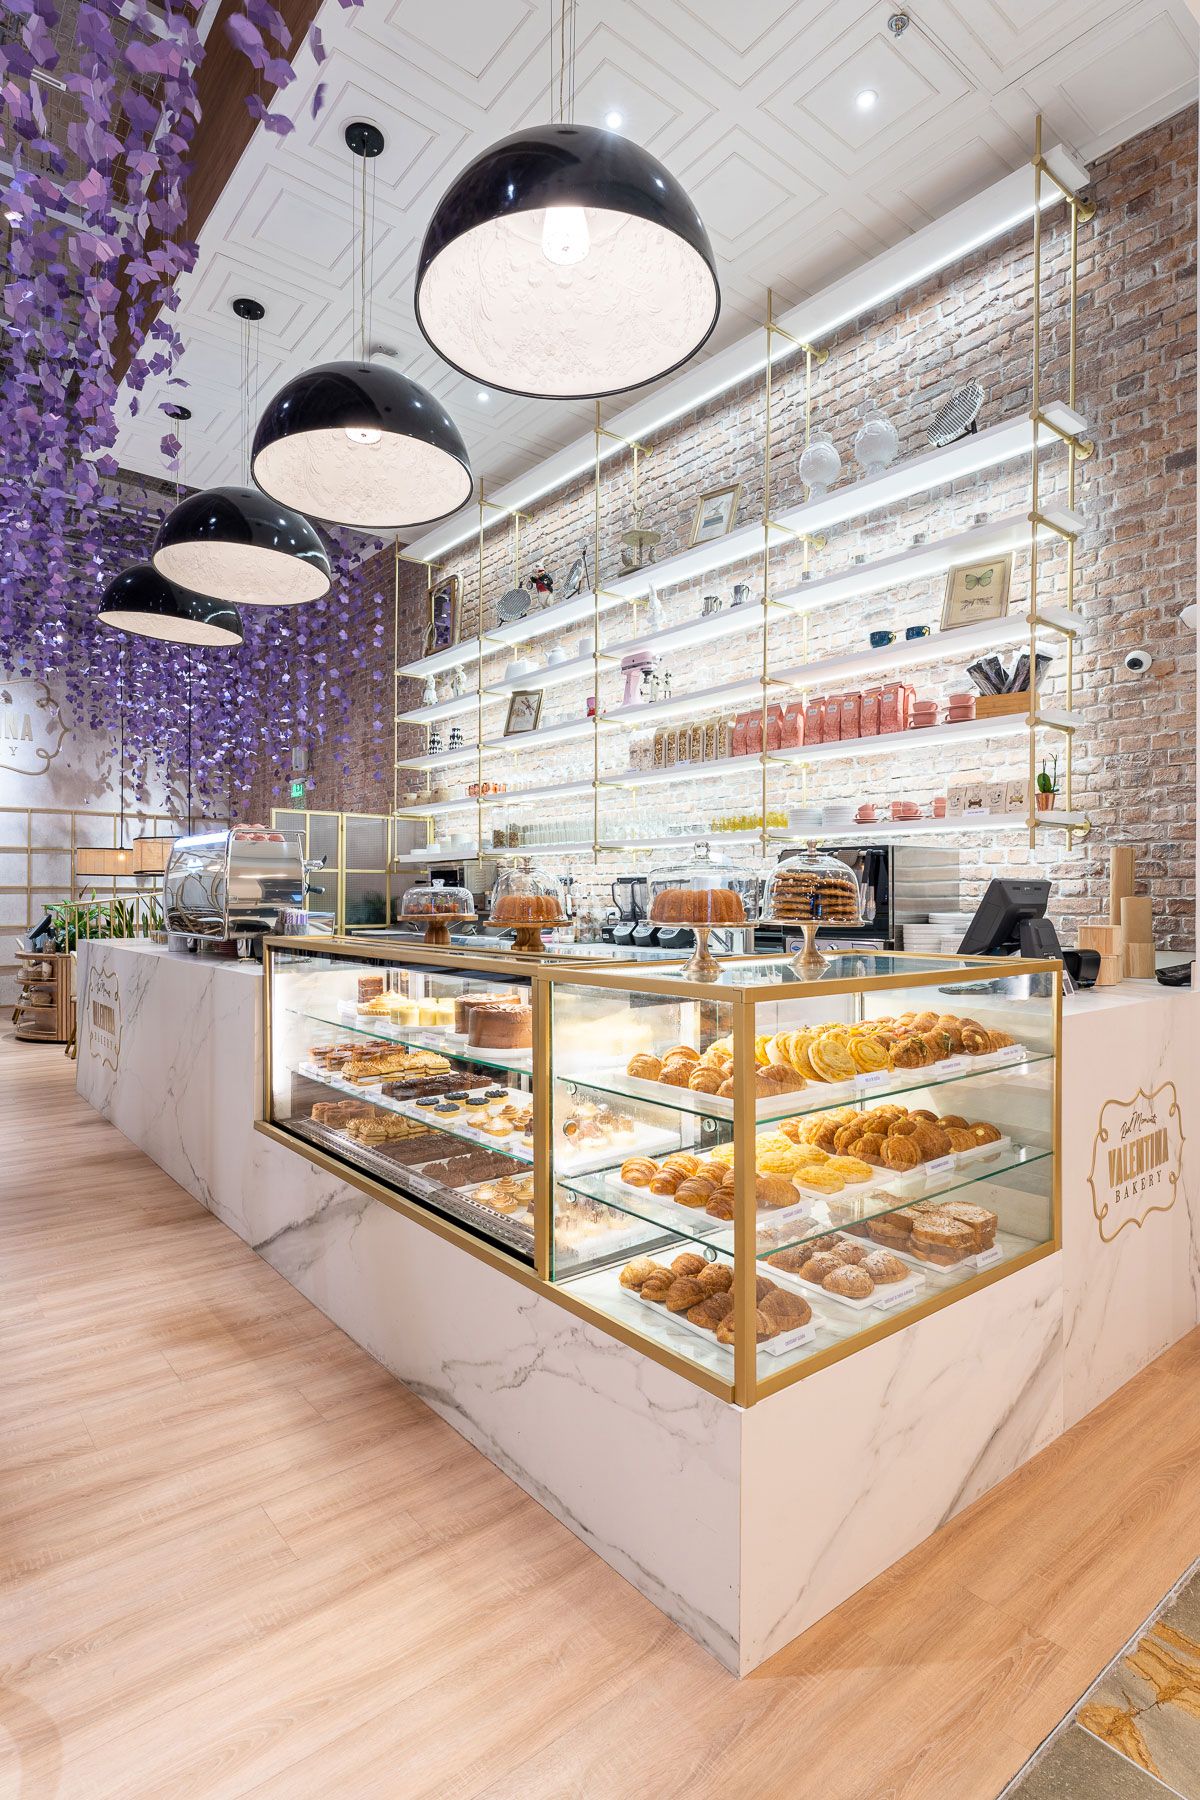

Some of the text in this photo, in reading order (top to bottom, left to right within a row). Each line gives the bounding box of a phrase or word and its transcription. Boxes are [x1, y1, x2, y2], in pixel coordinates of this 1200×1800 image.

[0, 711, 33, 741] NA
[1108, 1127, 1169, 1188] VALENTINA
[1115, 1169, 1162, 1203] BAKERY
